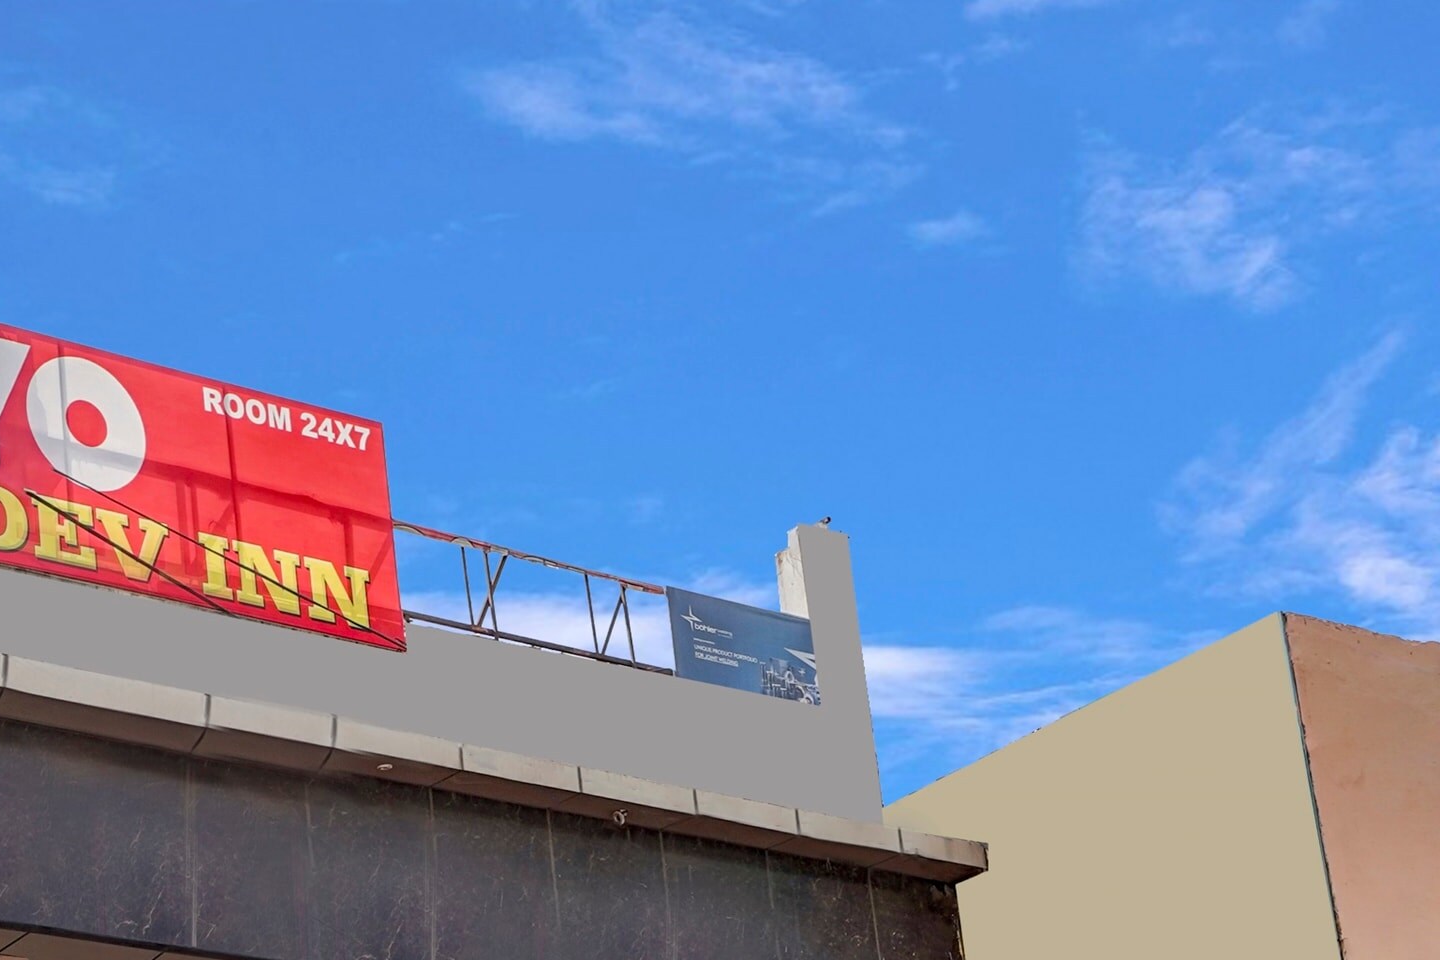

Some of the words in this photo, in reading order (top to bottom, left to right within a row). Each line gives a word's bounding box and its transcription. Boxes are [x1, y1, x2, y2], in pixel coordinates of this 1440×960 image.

[202, 386, 293, 433] ROOM
[301, 410, 372, 452] 24X7
[198, 530, 372, 630] INN
